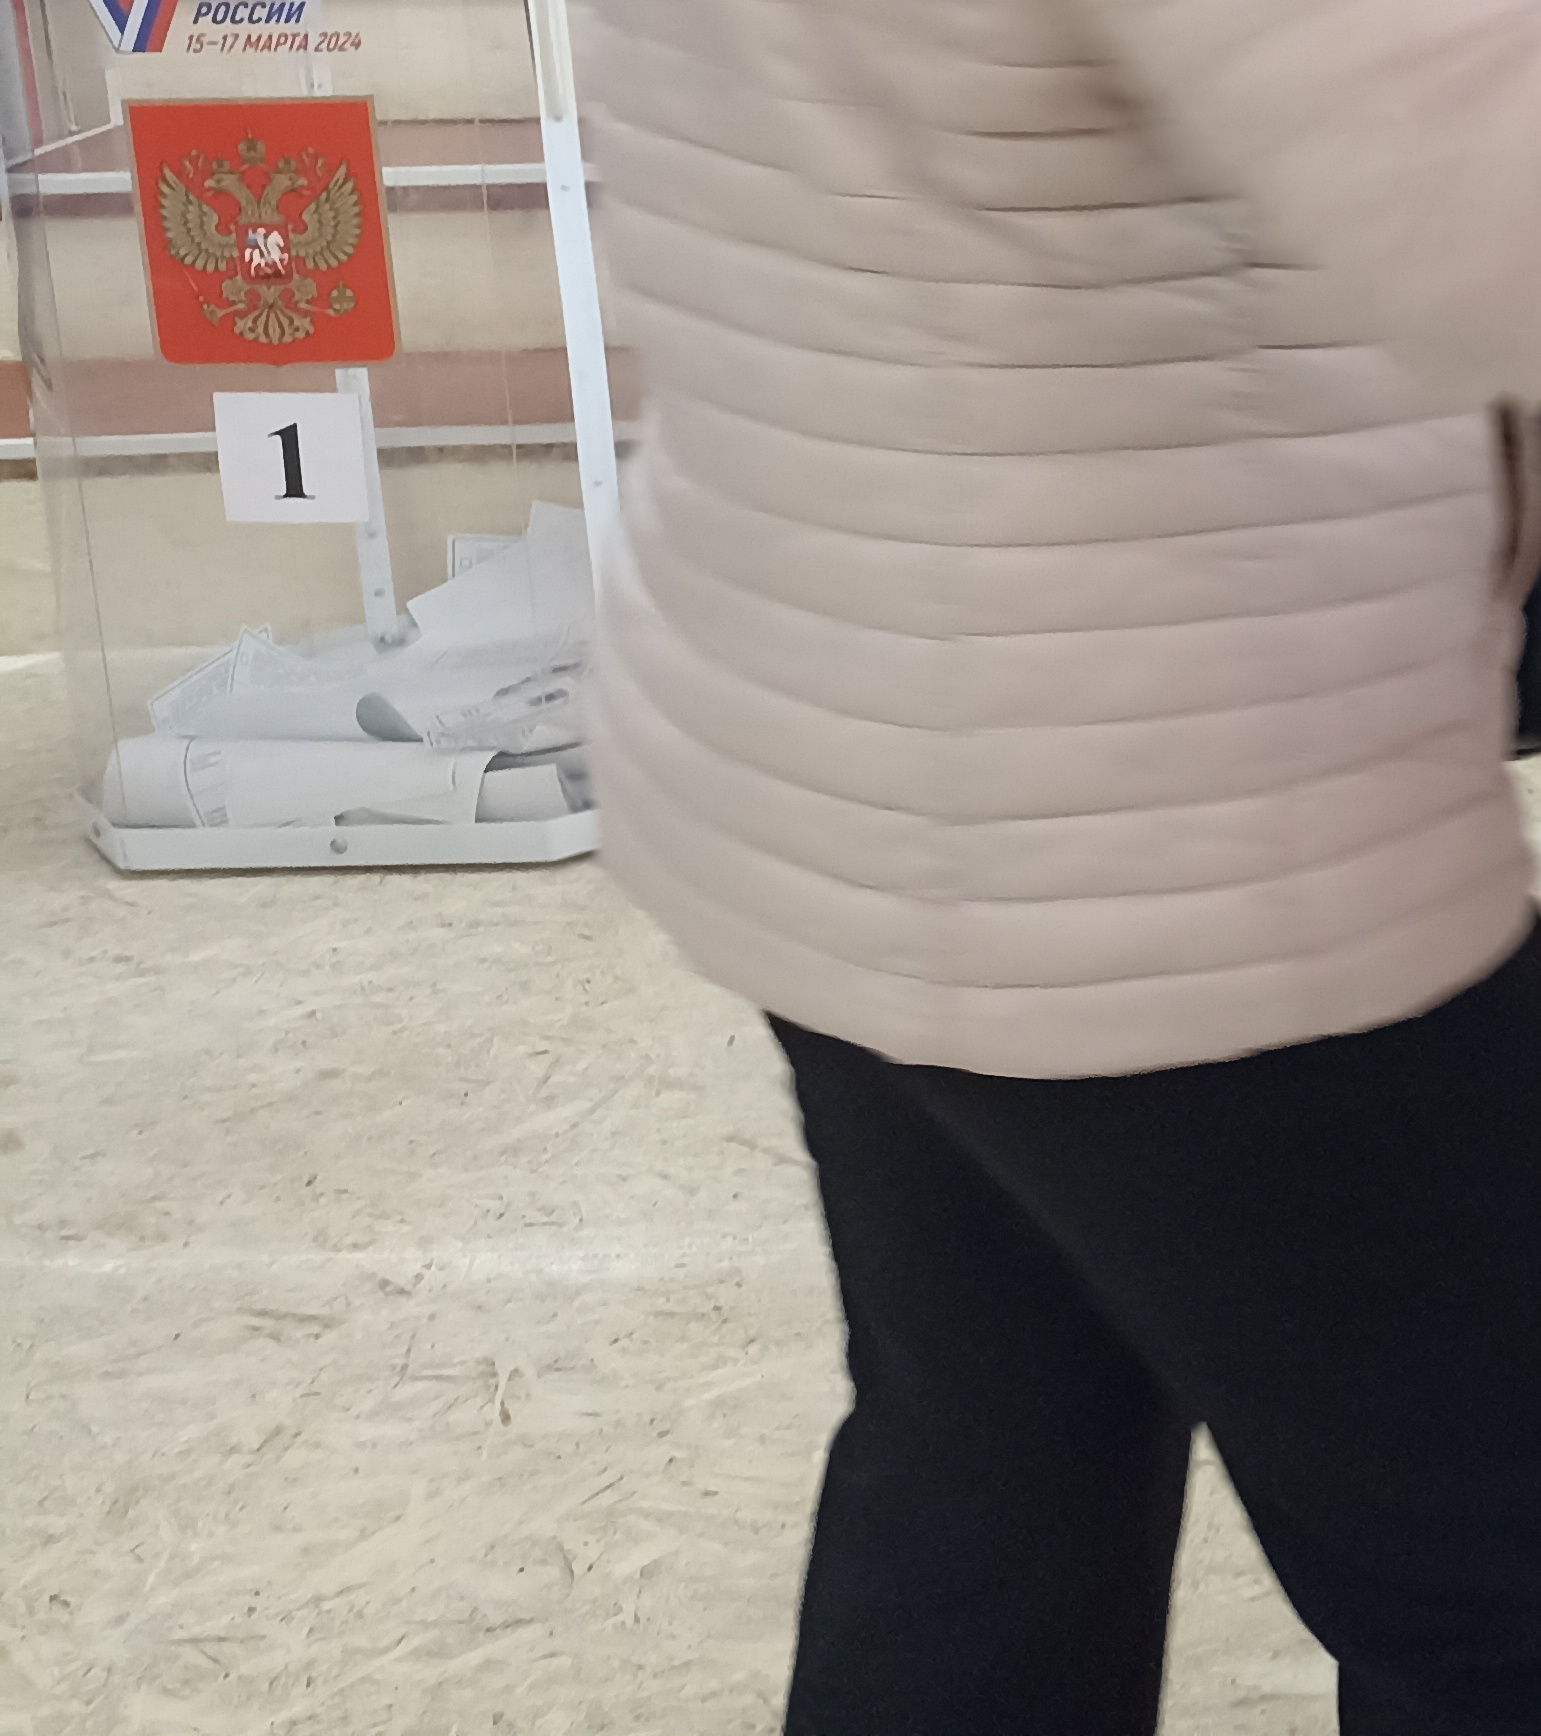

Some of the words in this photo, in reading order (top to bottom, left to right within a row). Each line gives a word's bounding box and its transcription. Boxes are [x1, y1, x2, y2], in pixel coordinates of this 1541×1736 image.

[193, 1, 306, 25] РОССИИ
[242, 33, 309, 53] МАРТА
[313, 31, 362, 53] 2024
[267, 422, 316, 501] 1
